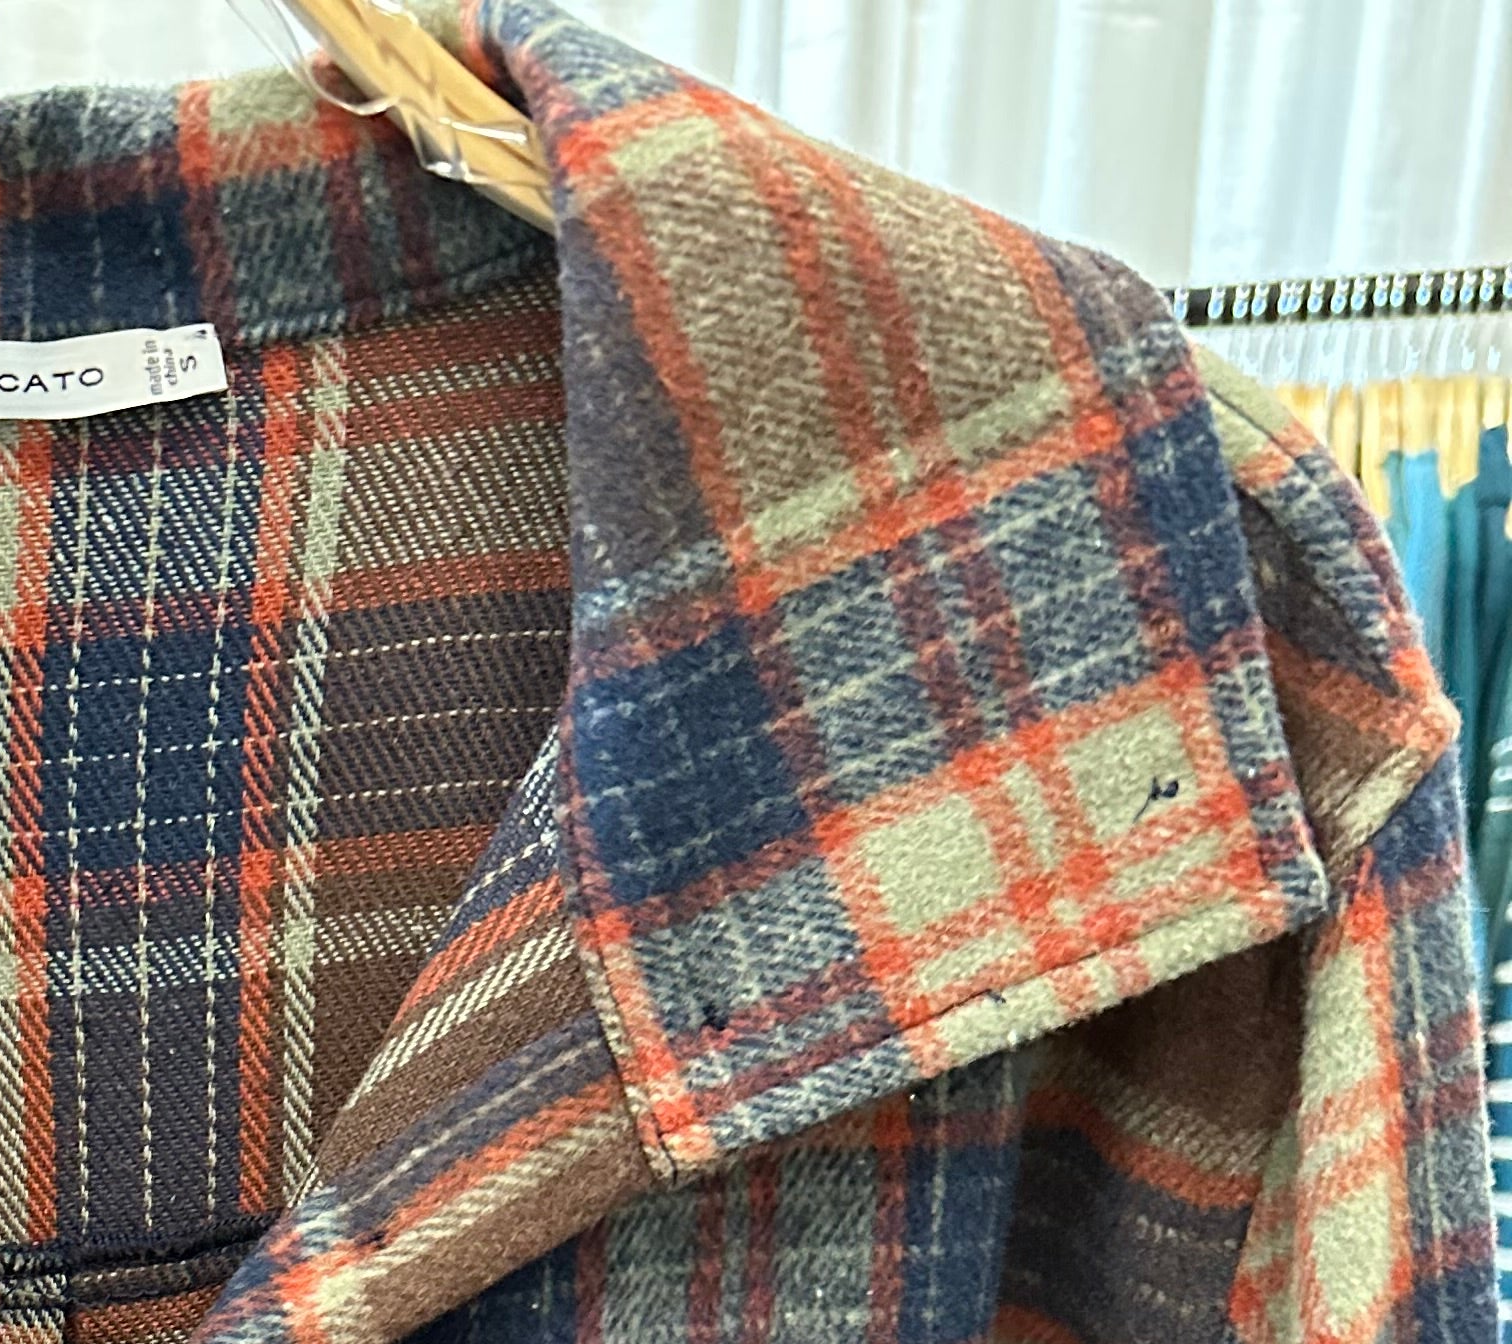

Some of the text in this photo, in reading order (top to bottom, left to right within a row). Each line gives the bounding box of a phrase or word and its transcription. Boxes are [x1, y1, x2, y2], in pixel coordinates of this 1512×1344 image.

[142, 340, 163, 395] made in
[180, 355, 197, 372] S
